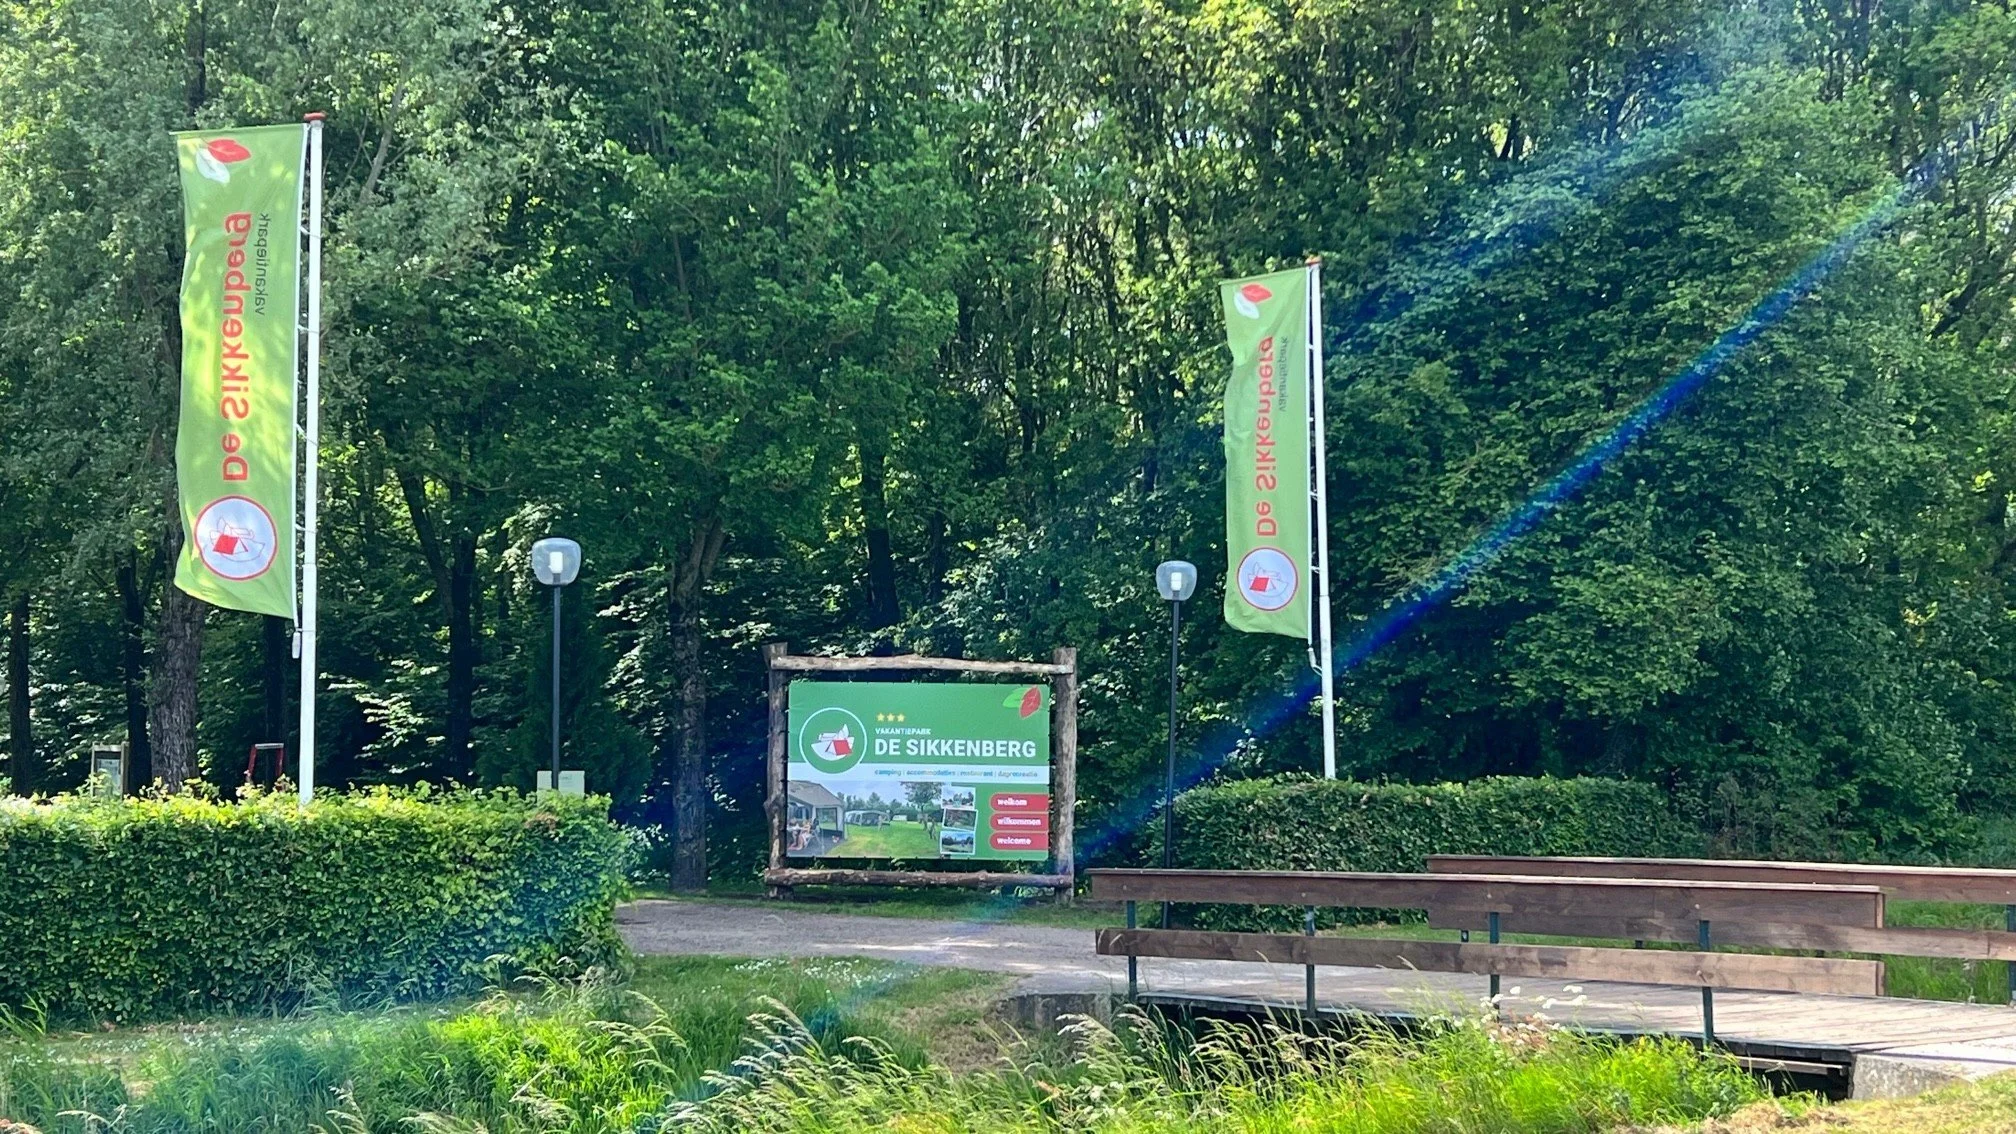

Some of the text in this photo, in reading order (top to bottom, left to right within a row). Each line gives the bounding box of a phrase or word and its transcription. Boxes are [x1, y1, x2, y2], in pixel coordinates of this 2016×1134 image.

[875, 727, 931, 735] VAKANTIEPARK
[875, 738, 1036, 757] DE SIKKENBERG
[997, 797, 1028, 806] welkom
[996, 836, 1032, 845] welcome
